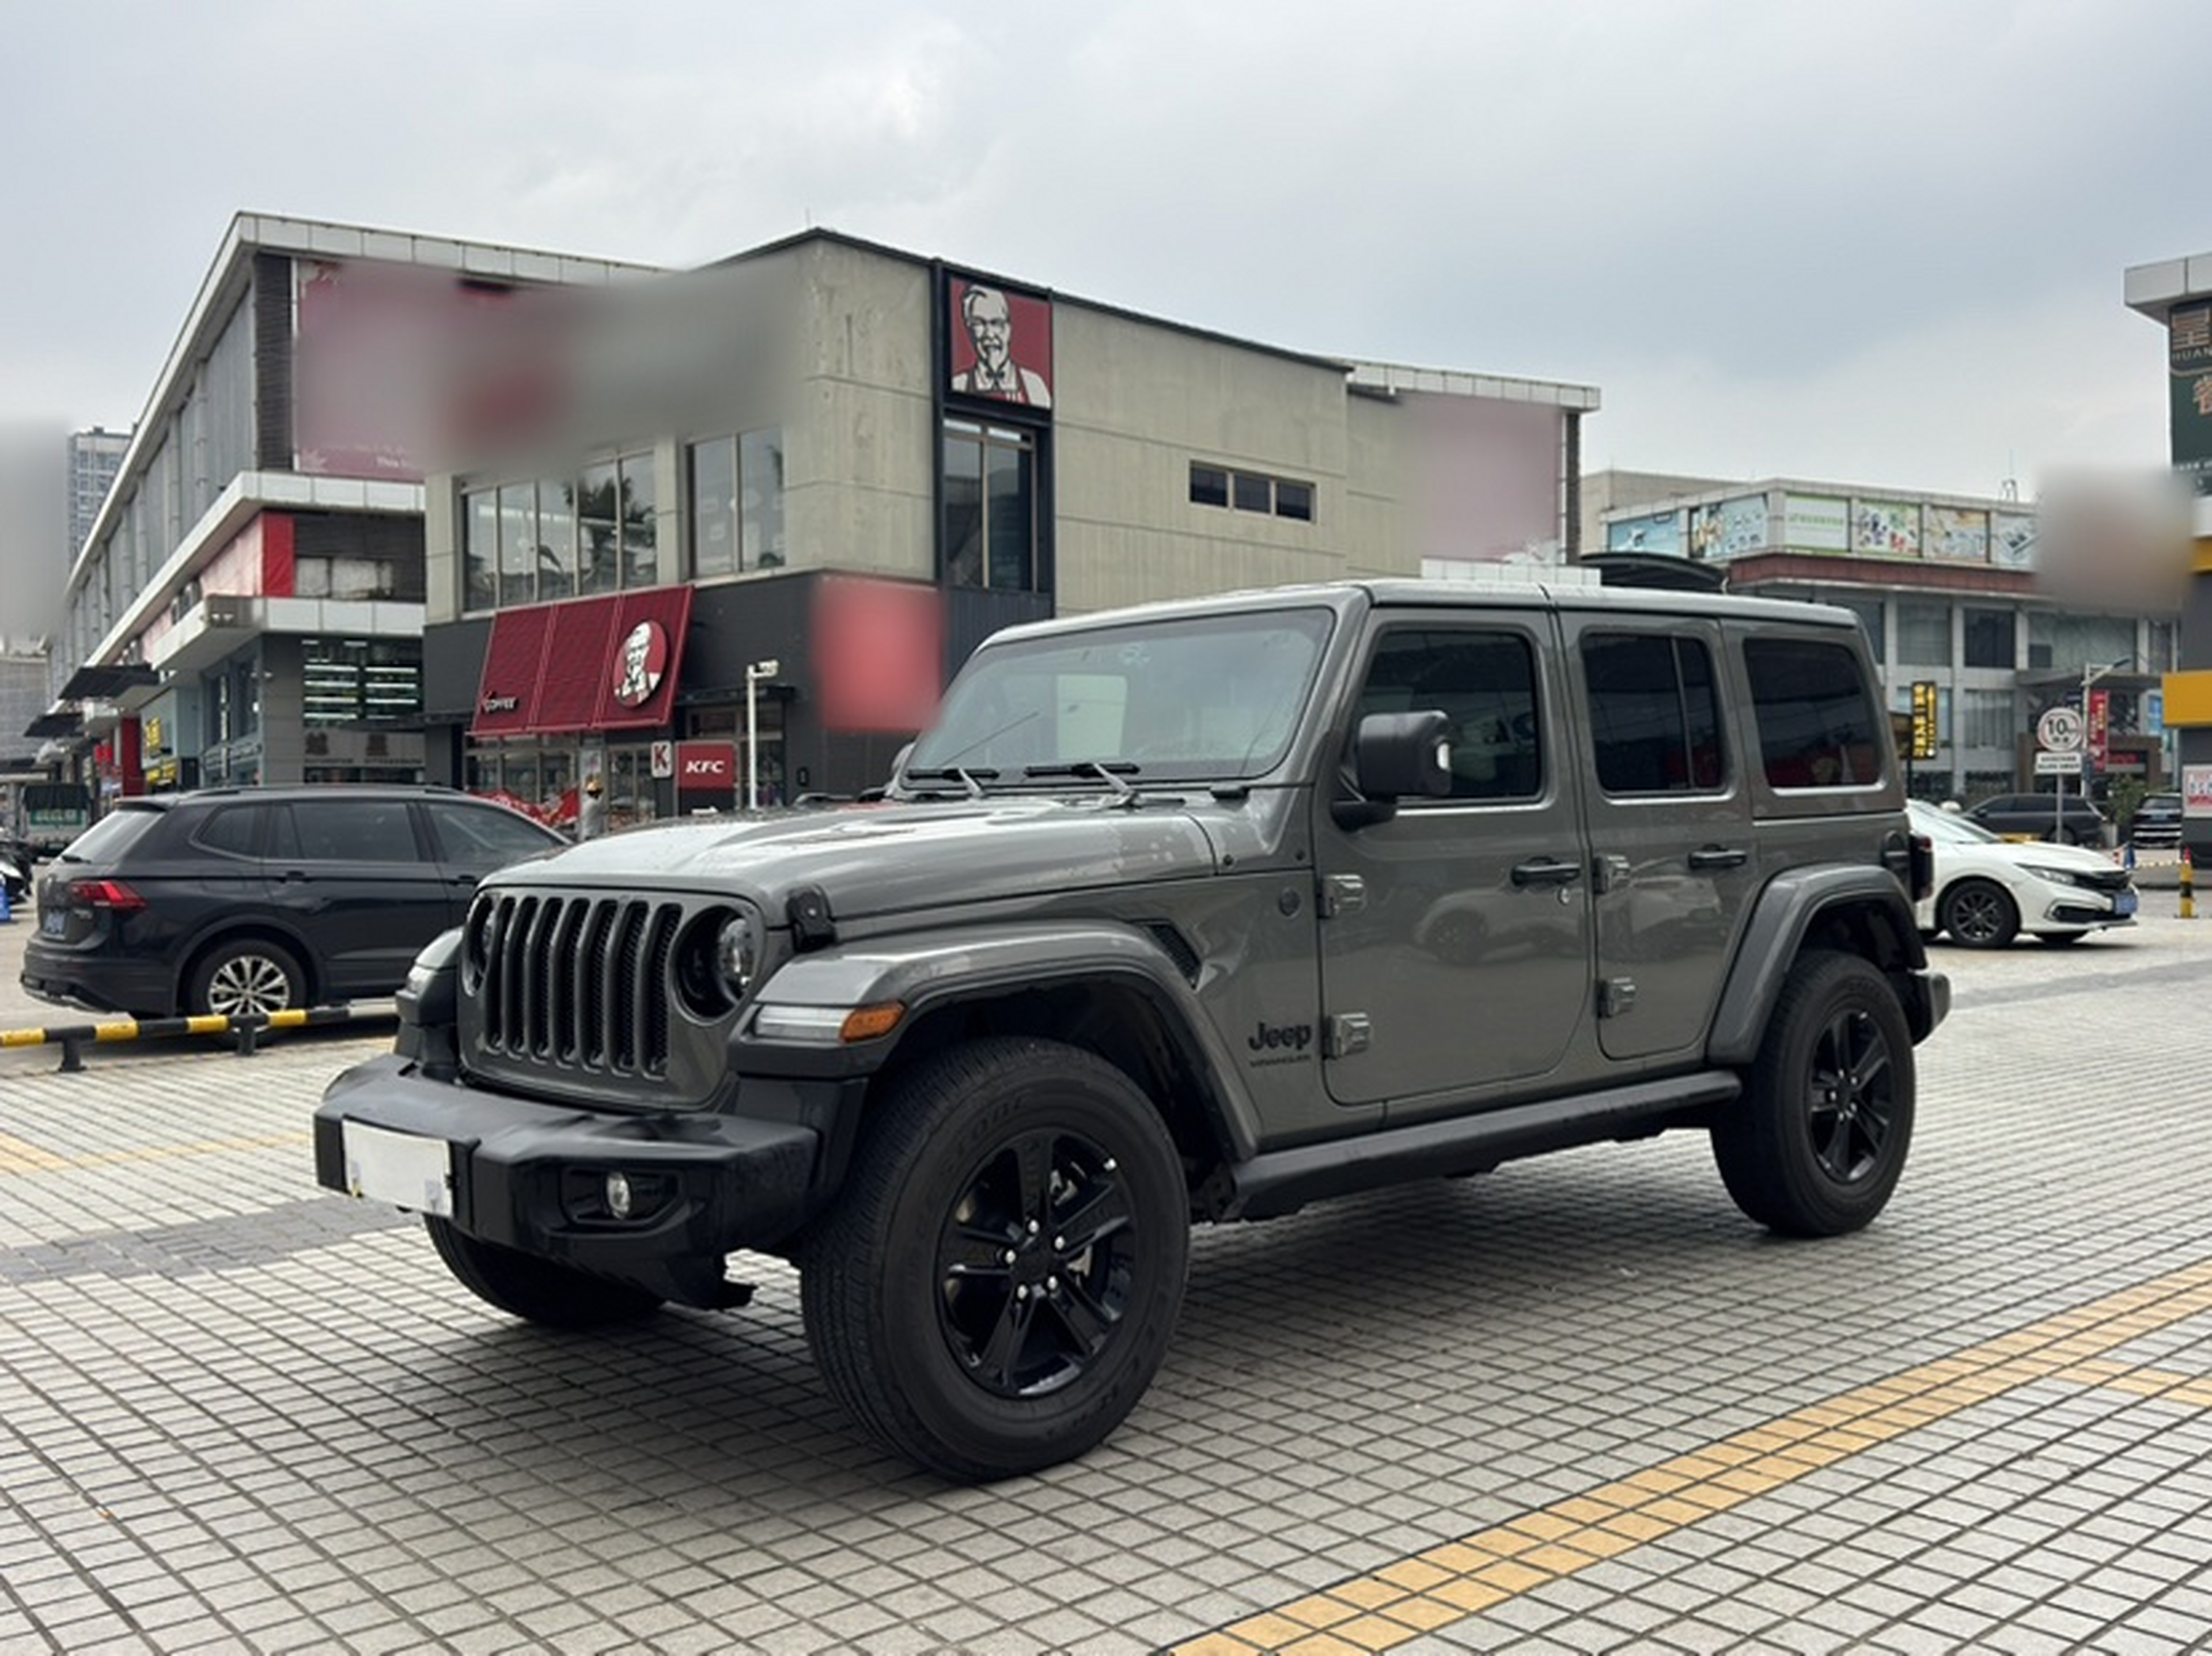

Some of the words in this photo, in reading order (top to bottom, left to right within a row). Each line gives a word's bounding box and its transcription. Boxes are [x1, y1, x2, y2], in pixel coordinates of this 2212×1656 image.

[2048, 718, 2068, 735] 10
[654, 744, 668, 770] K
[685, 760, 725, 774] KFC
[1248, 1021, 1312, 1051] Jeep
